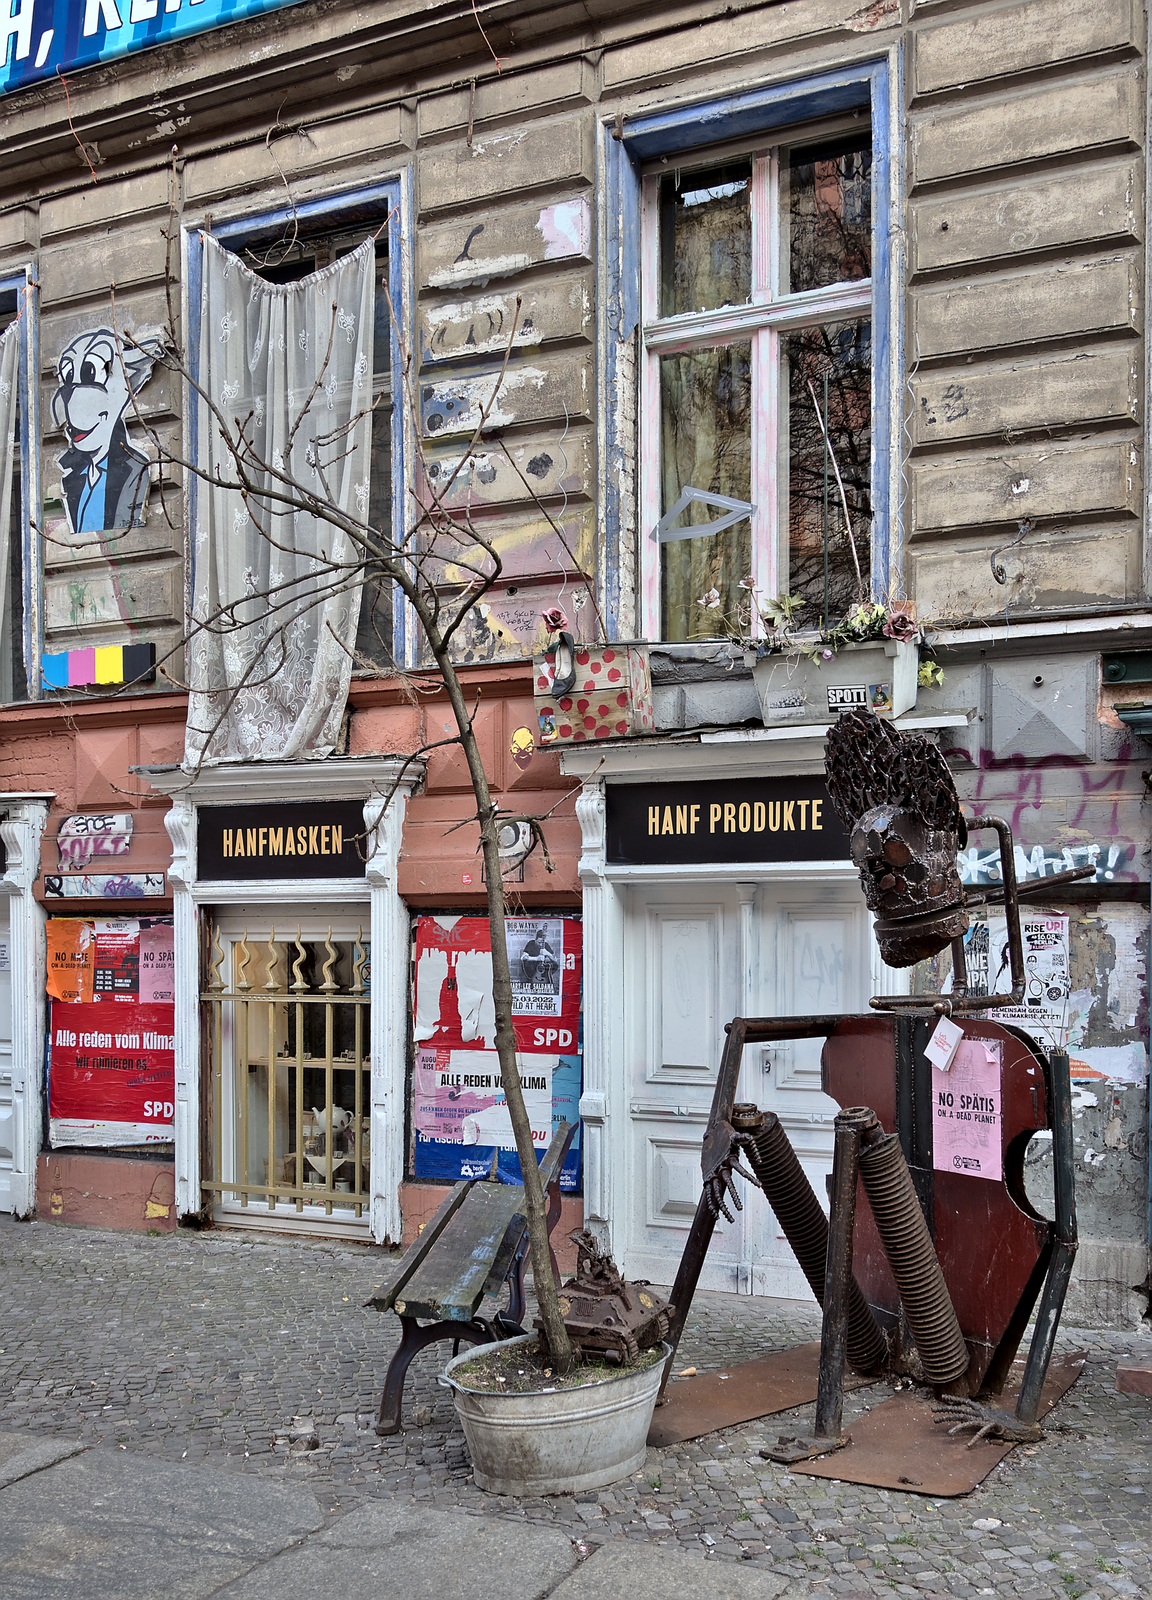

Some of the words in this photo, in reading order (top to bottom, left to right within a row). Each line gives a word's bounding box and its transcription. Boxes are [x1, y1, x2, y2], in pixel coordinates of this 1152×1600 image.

[828, 689, 866, 703] SPOTT
[648, 804, 701, 836] HANF
[709, 799, 823, 834] PRODUKTE
[223, 825, 342, 858] HANFMASKEN
[519, 922, 539, 930] WAYNE
[1024, 924, 1046, 933] RISE
[1046, 920, 1064, 933] UP!
[55, 952, 67, 962] NO
[70, 952, 89, 962] MATE
[143, 952, 155, 961] NO
[159, 950, 175, 962] SPÄT
[512, 1002, 523, 1010] ILD
[526, 1002, 534, 1010] AT
[536, 1003, 557, 1012] HEART
[56, 1030, 77, 1047] Alle
[79, 1031, 112, 1049] reden
[115, 1034, 139, 1049] vom
[143, 1031, 175, 1050] Klima
[533, 1028, 572, 1047] SPD
[76, 1054, 90, 1068] wir
[92, 1055, 134, 1070] ruinieren
[136, 1058, 150, 1071] es.
[440, 1073, 461, 1086] ALLE
[463, 1074, 491, 1088] REDEN
[520, 1077, 547, 1090] KLIMA
[143, 1100, 174, 1118] SPD
[938, 1092, 954, 1107] NO
[960, 1093, 995, 1113] SPÄTIS
[937, 1108, 947, 1118] ON
[949, 1110, 954, 1119] A
[956, 1111, 972, 1121] DEAD
[974, 1114, 996, 1125] PLANET
[531, 1130, 547, 1141] DU
